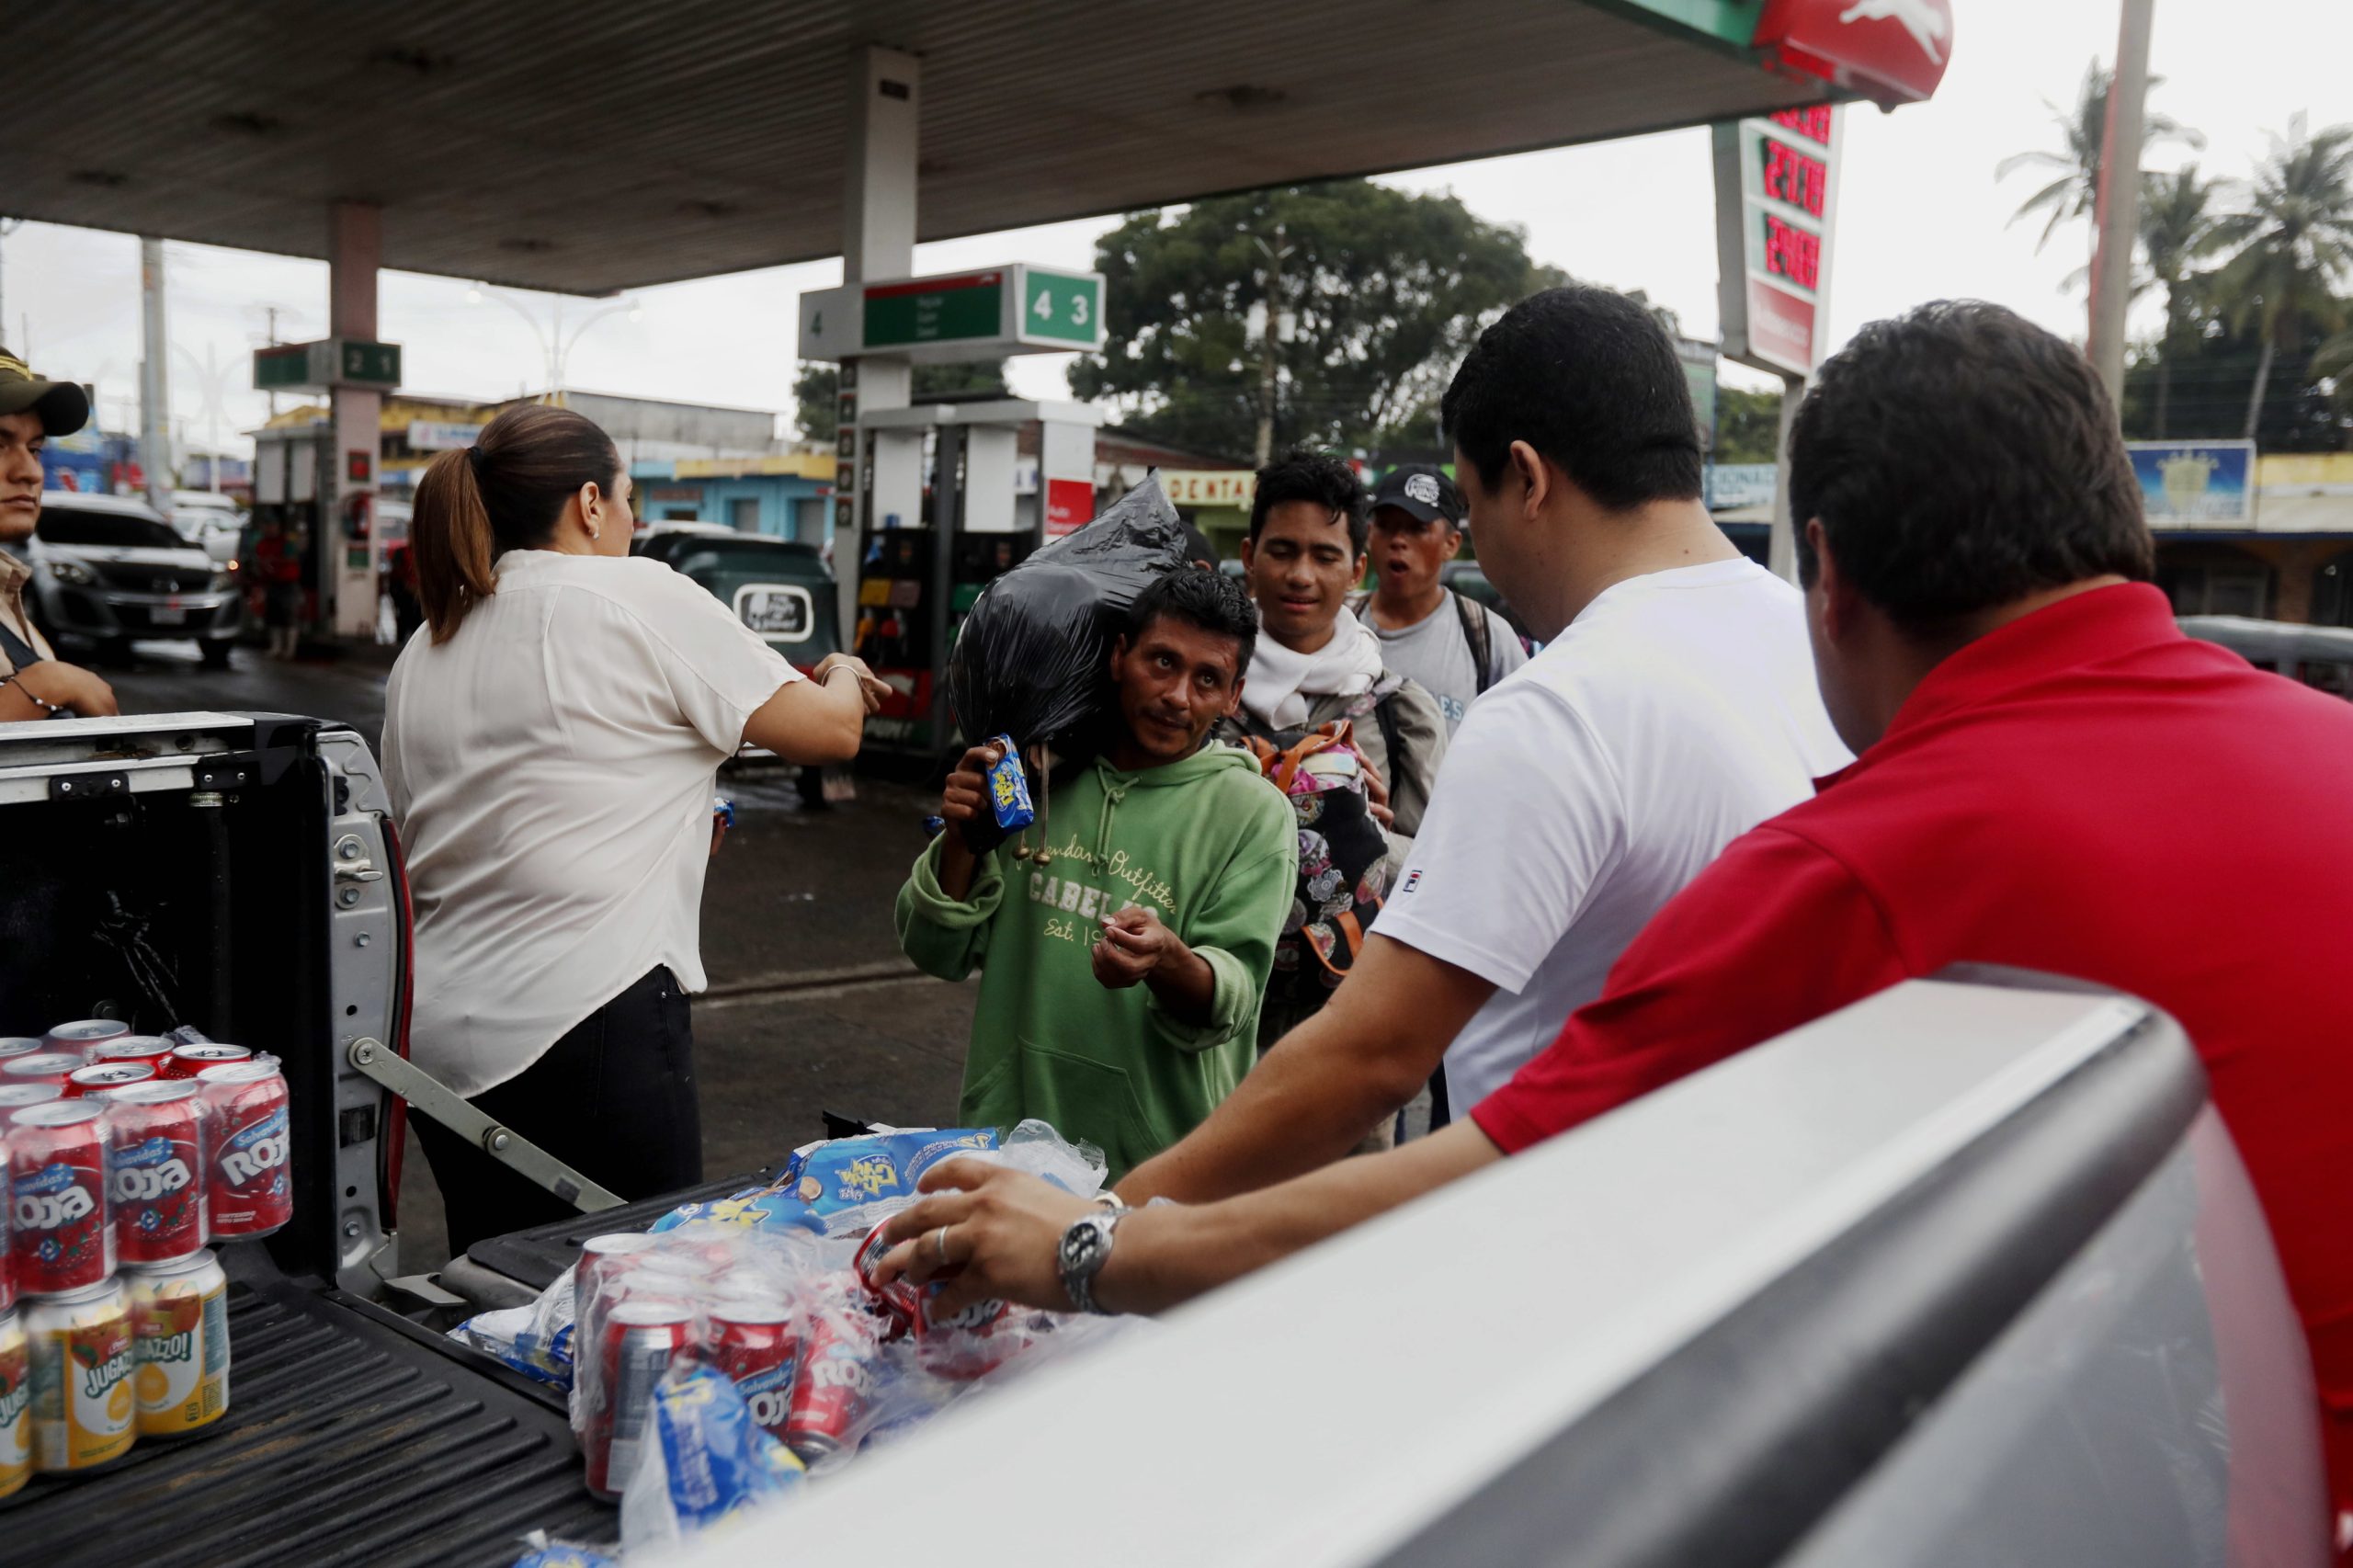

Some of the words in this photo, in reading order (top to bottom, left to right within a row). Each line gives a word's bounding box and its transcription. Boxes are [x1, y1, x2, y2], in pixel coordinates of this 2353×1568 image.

[1033, 290, 1053, 321] 4
[1072, 294, 1088, 325] 3
[811, 312, 823, 337] 4
[1043, 918, 1074, 942] Est.
